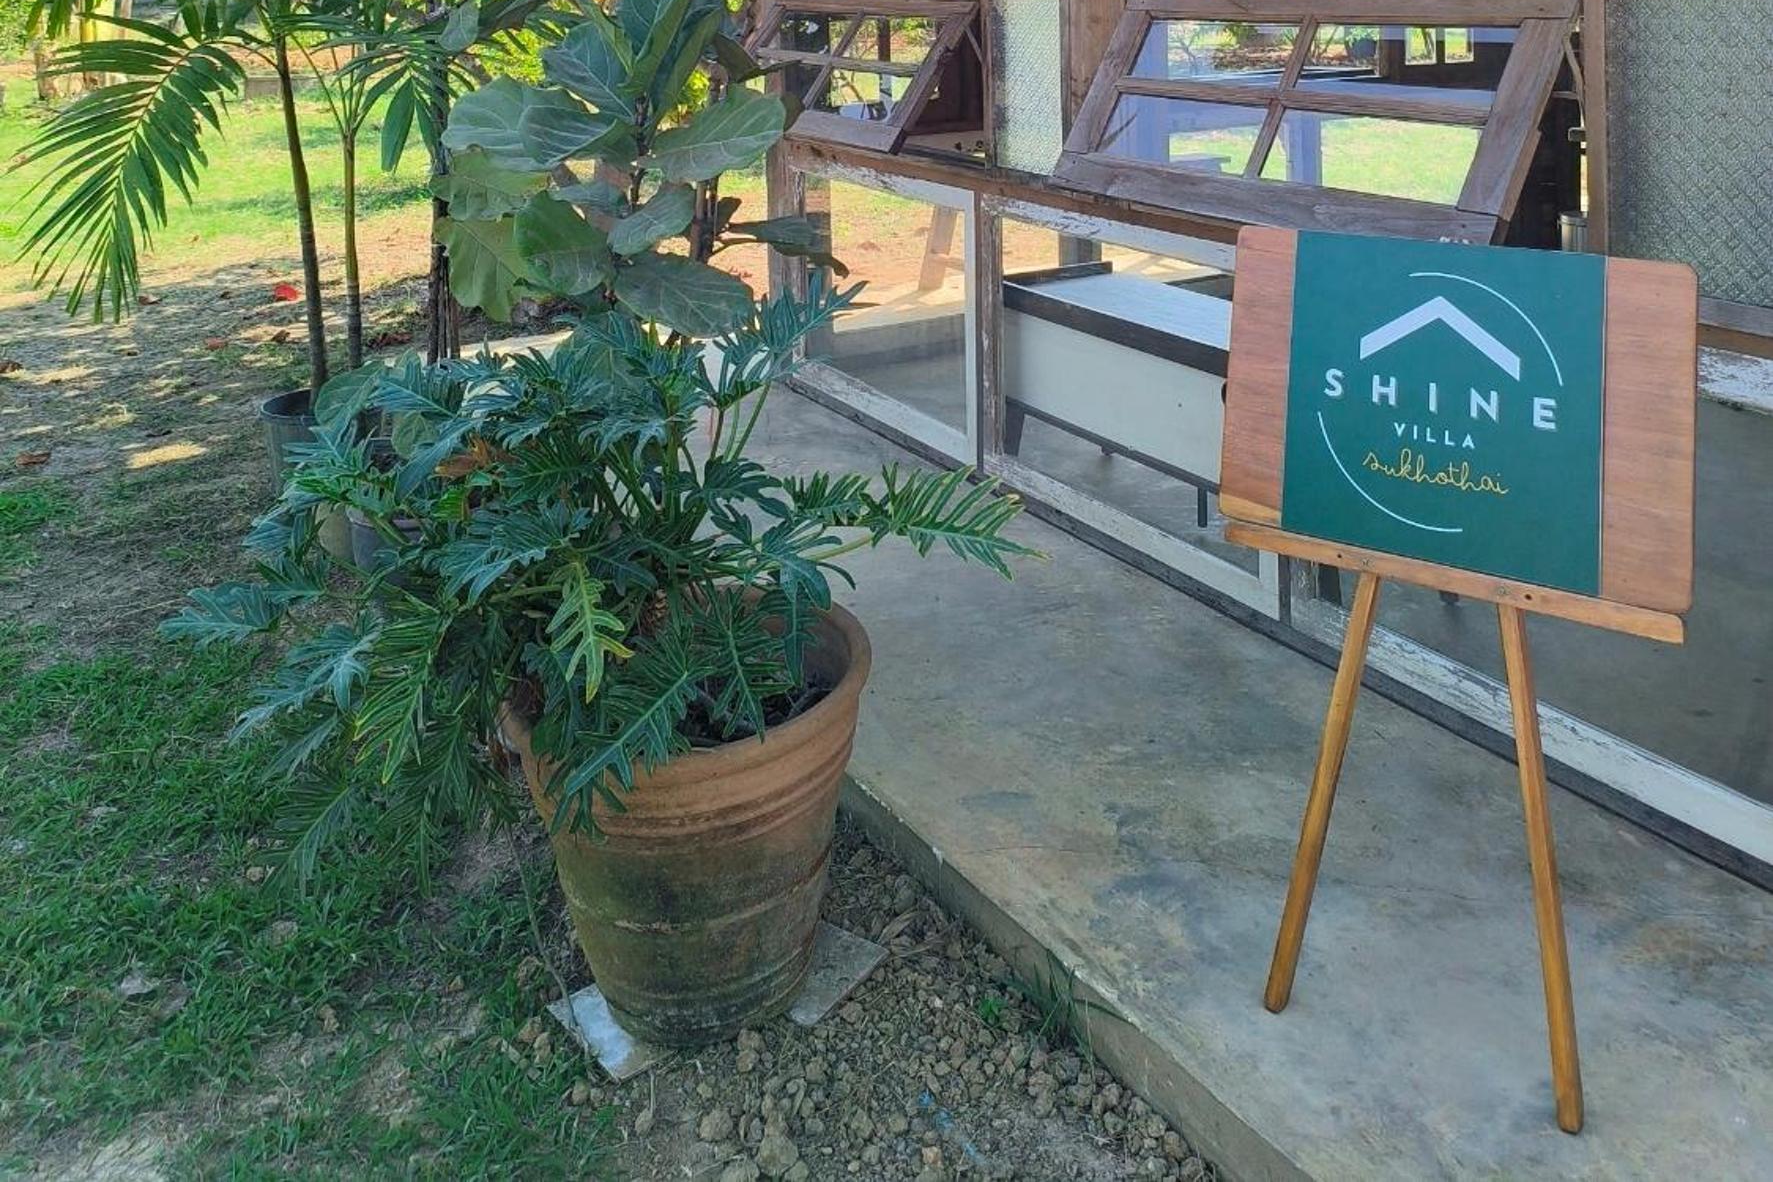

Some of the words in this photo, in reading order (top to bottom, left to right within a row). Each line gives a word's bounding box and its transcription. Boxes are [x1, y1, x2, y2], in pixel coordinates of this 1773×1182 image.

[1325, 369, 1557, 430] SHINE
[1394, 422, 1476, 449] VILLA
[1362, 449, 1510, 495] sukhothai
